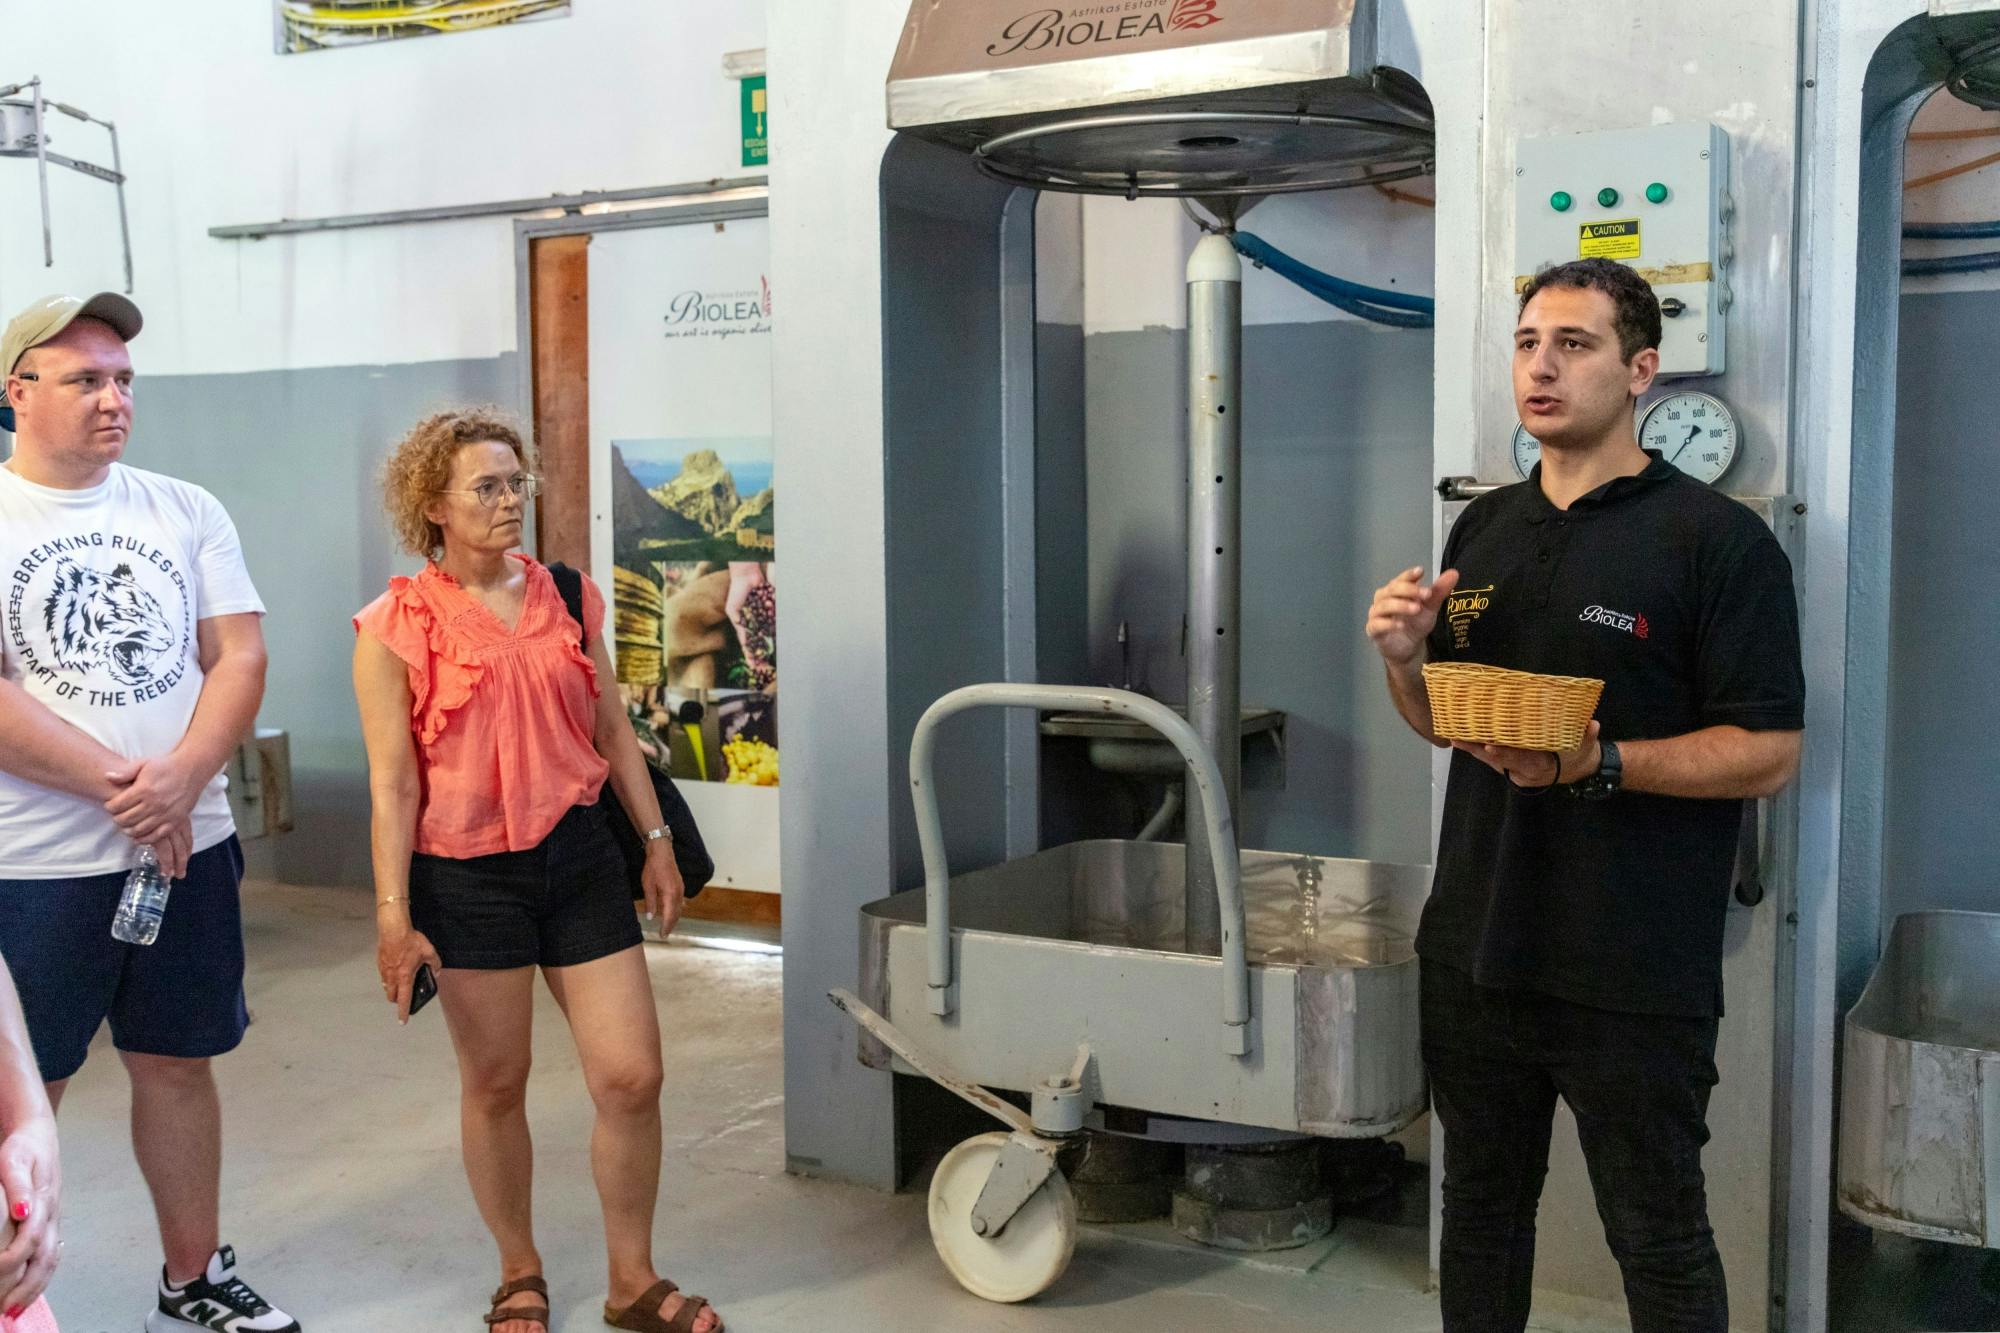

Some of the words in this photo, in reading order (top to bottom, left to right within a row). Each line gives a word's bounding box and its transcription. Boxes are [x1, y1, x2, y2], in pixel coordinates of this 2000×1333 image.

[1069, 4, 1120, 18] Astrikas
[1124, 0, 1167, 11] Estate
[986, 9, 1165, 56] BIOLEA
[1593, 224, 1625, 236] CAUTION
[664, 289, 762, 325] BIOLEA
[1667, 411, 1681, 420] 400
[1692, 408, 1706, 418] 600
[1709, 428, 1723, 438] 800
[1527, 441, 1539, 450] 200
[1654, 435, 1667, 445] 200
[1702, 453, 1719, 462] 1000
[13, 532, 103, 584] BREAKING
[111, 535, 173, 573] RULES
[1579, 605, 1633, 633] BIOLEA
[20, 647, 58, 685] PART
[56, 681, 83, 701] OF
[89, 690, 126, 707] THE
